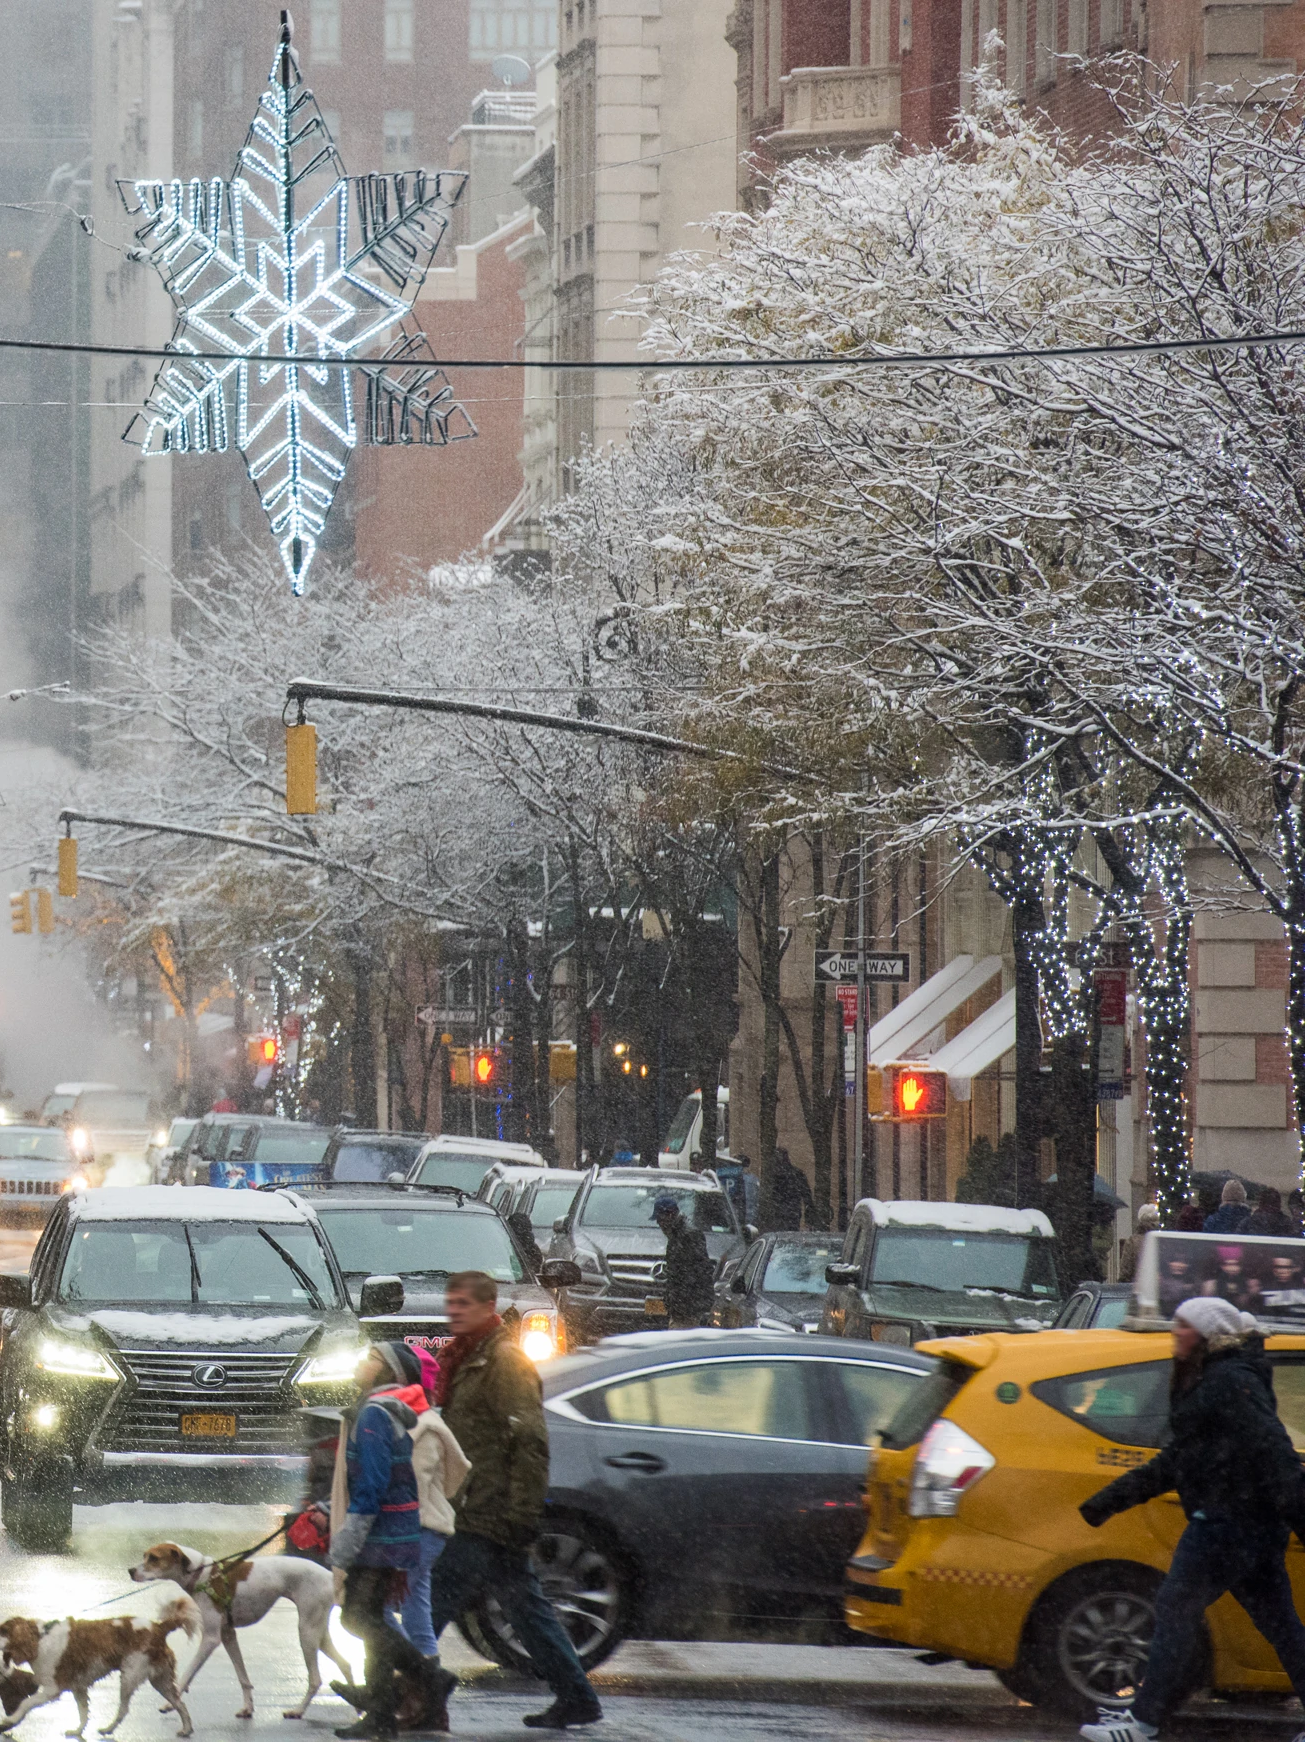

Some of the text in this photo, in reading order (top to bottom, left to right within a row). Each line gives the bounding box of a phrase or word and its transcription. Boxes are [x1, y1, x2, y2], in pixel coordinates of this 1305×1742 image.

[1099, 948, 1114, 965] St
[829, 961, 897, 973] ONE WAY
